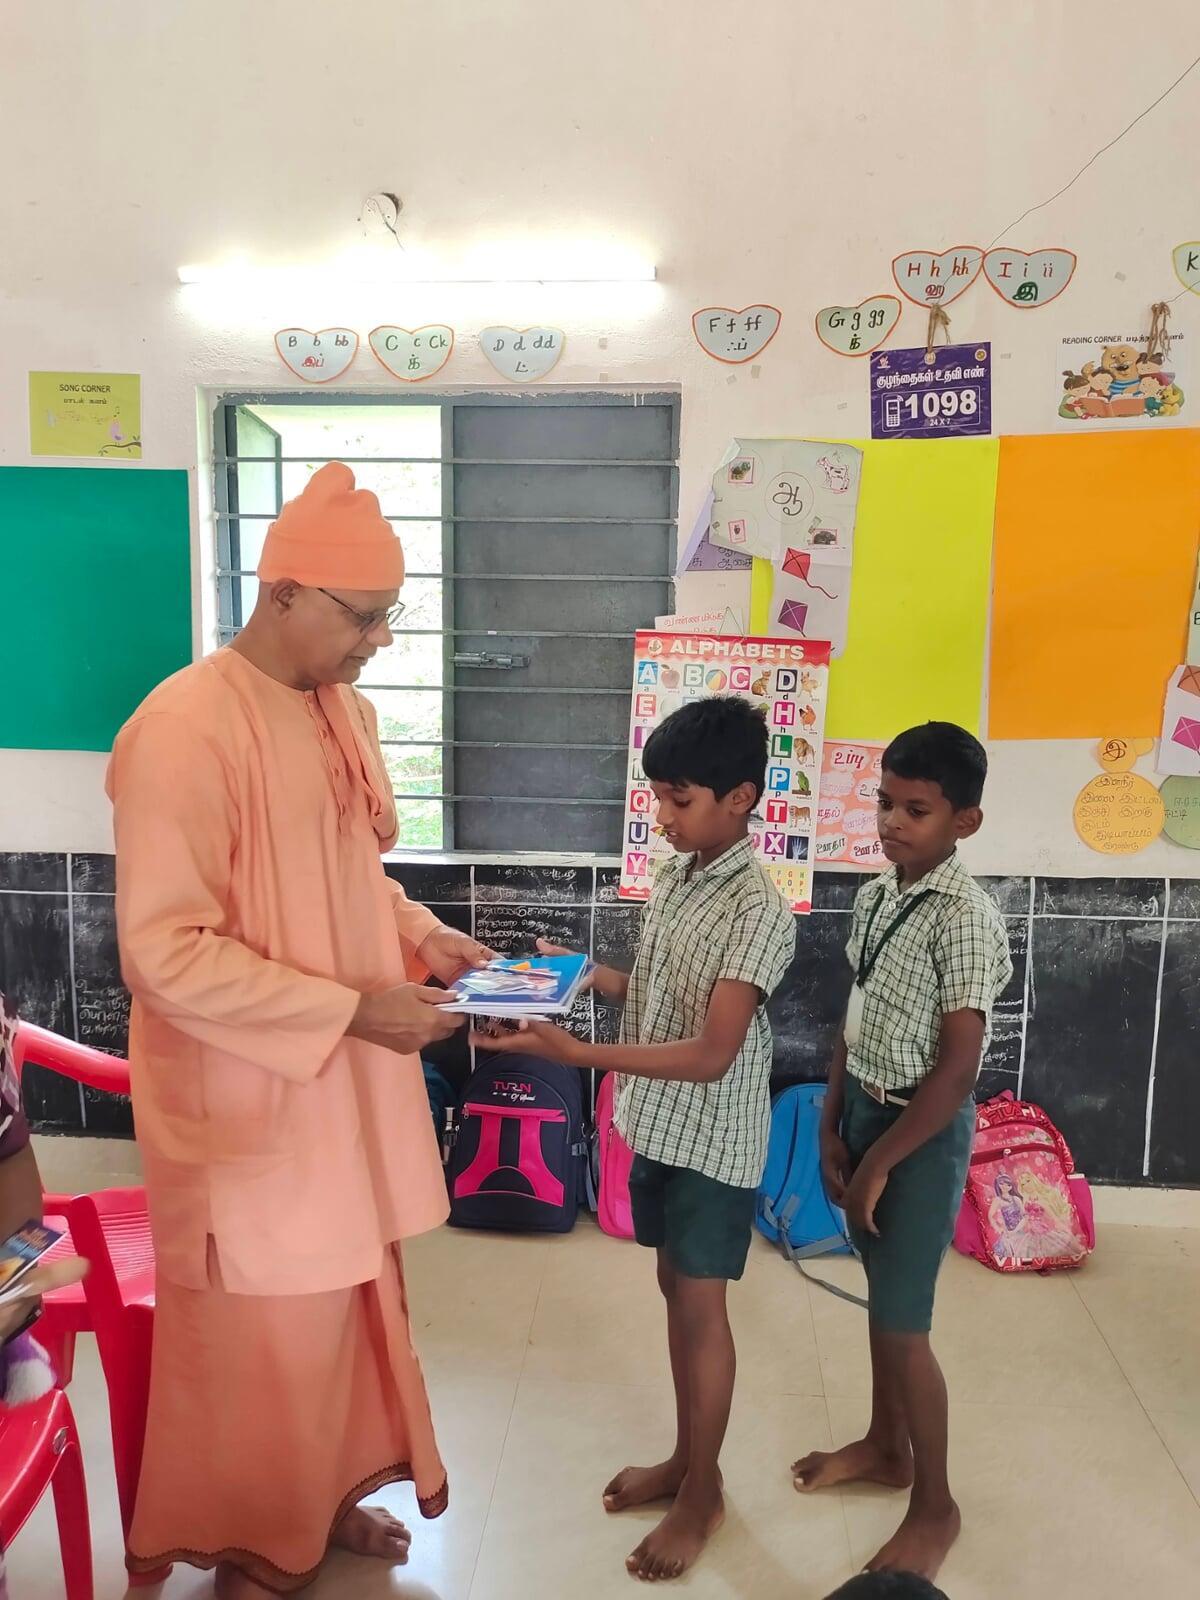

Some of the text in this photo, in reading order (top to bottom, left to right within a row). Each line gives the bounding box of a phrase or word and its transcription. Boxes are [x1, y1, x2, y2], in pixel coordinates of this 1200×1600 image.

[907, 262, 920, 277] H
[930, 259, 940, 277] h
[998, 262, 1053, 278] I i ii
[709, 315, 762, 333] F f ff
[828, 309, 884, 331] G g gg
[288, 334, 349, 347] B b bb
[385, 335, 399, 351] C
[413, 337, 421, 347] c
[493, 335, 556, 352] D d dd
[1062, 336, 1092, 345] READING
[1094, 335, 1122, 344] CORNER
[877, 364, 985, 389] குழந்தைகள் உதவி எண்
[59, 384, 111, 393] SONG CORNER
[905, 389, 977, 419] 1098
[930, 418, 938, 426] 24
[772, 481, 803, 517] ஆ
[670, 638, 805, 661] ALPHABETS
[638, 663, 796, 691] A B C D
[638, 696, 794, 724] E H
[774, 736, 788, 756] L
[771, 769, 788, 789] P
[632, 791, 785, 821] Q T
[631, 823, 784, 854] U X
[629, 854, 646, 875] Y
